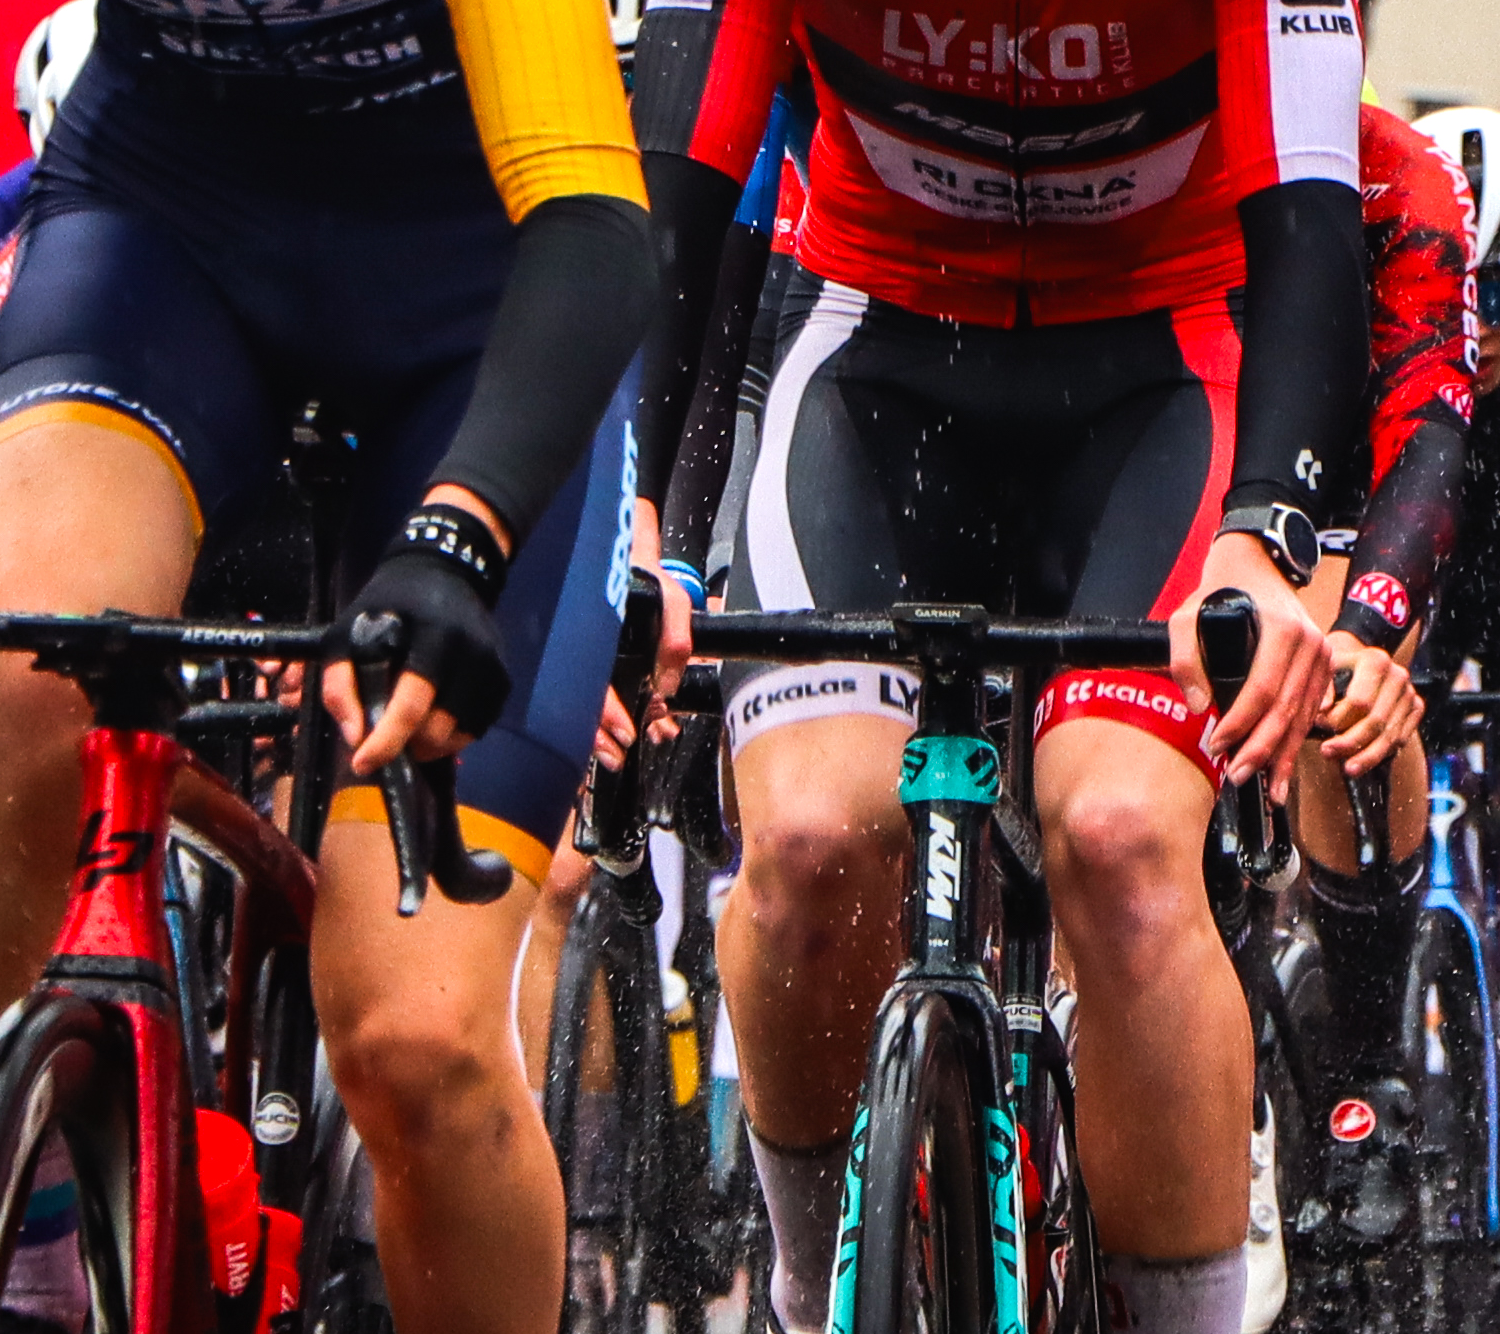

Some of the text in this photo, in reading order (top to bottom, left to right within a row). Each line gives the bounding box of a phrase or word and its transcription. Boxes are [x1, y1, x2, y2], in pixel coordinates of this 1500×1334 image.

[882, 8, 1101, 82] LY:KO
[1106, 21, 1131, 77] KLUB
[1279, 13, 1354, 37] KLUB
[914, 608, 962, 619] GARMIN
[924, 811, 956, 921] KTM
